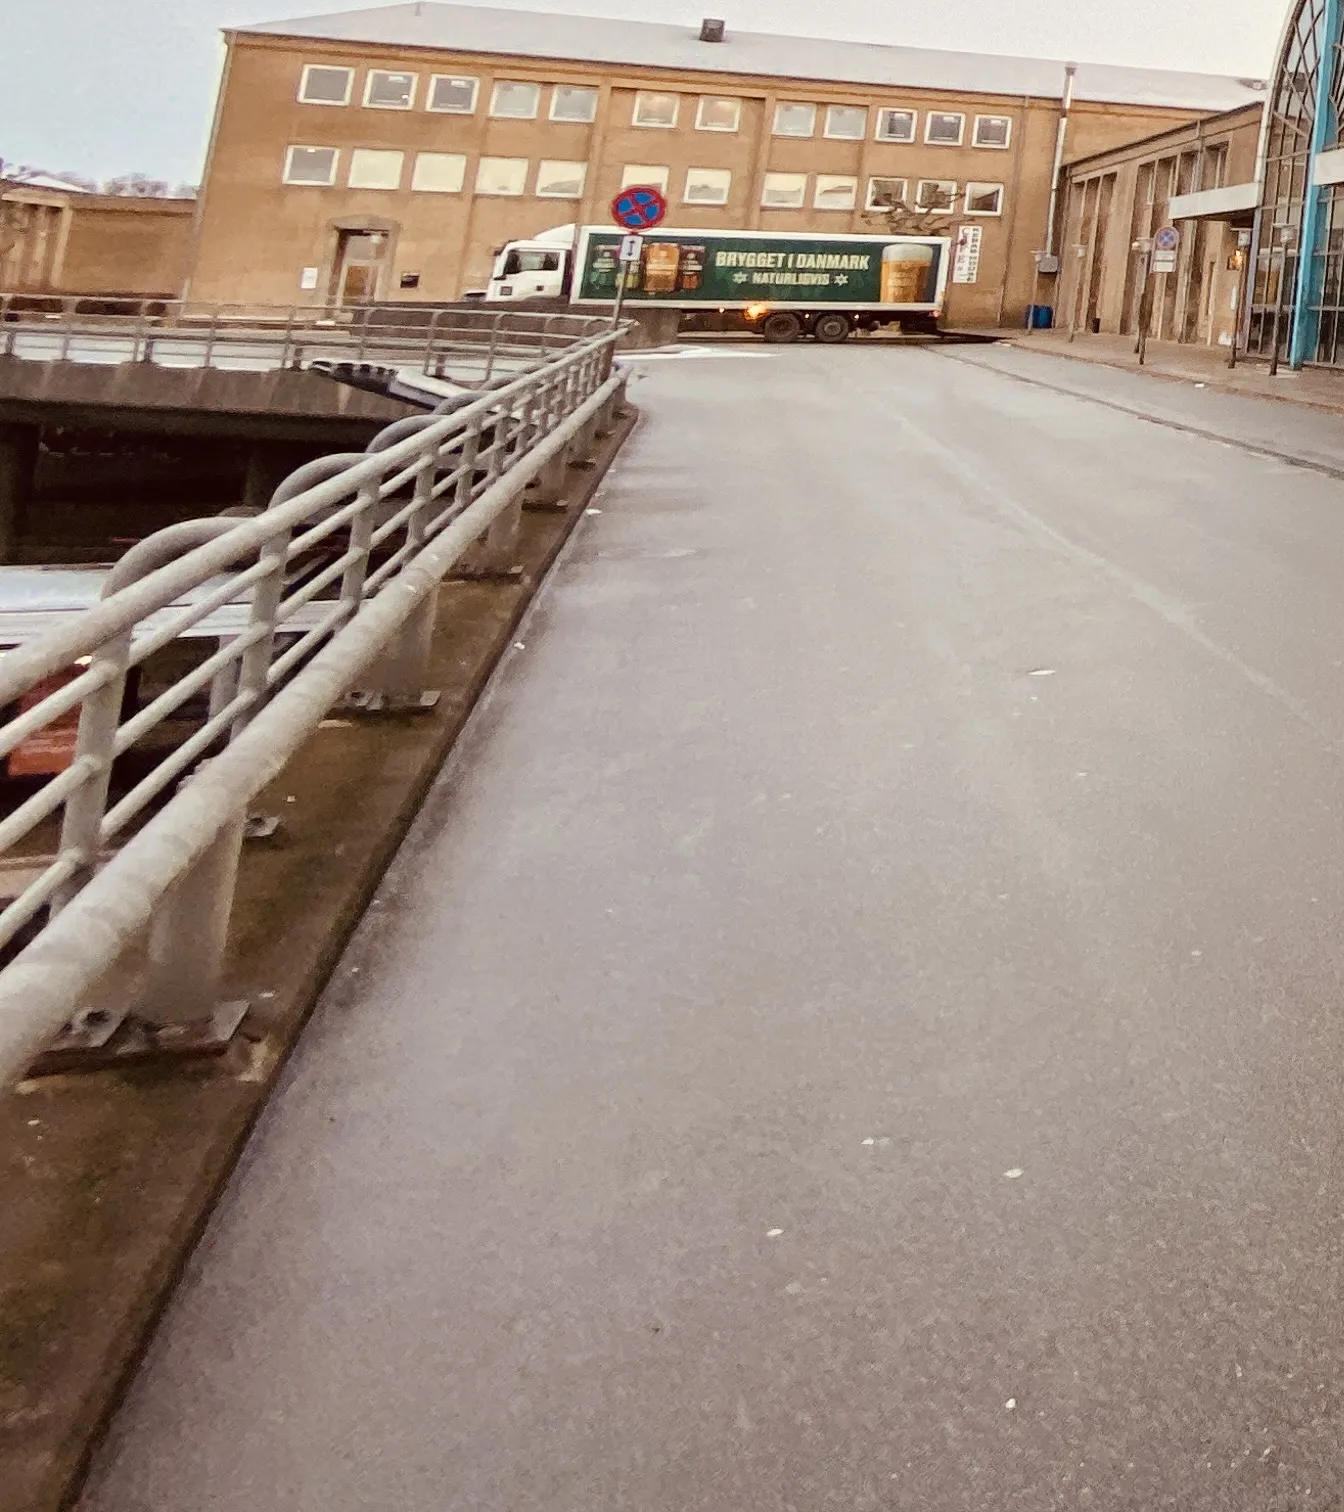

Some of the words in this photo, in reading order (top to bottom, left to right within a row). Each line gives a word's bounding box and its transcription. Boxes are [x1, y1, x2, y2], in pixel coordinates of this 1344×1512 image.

[715, 251, 787, 267] BRYGGET
[787, 253, 793, 268] I
[795, 253, 870, 270] DANMARK
